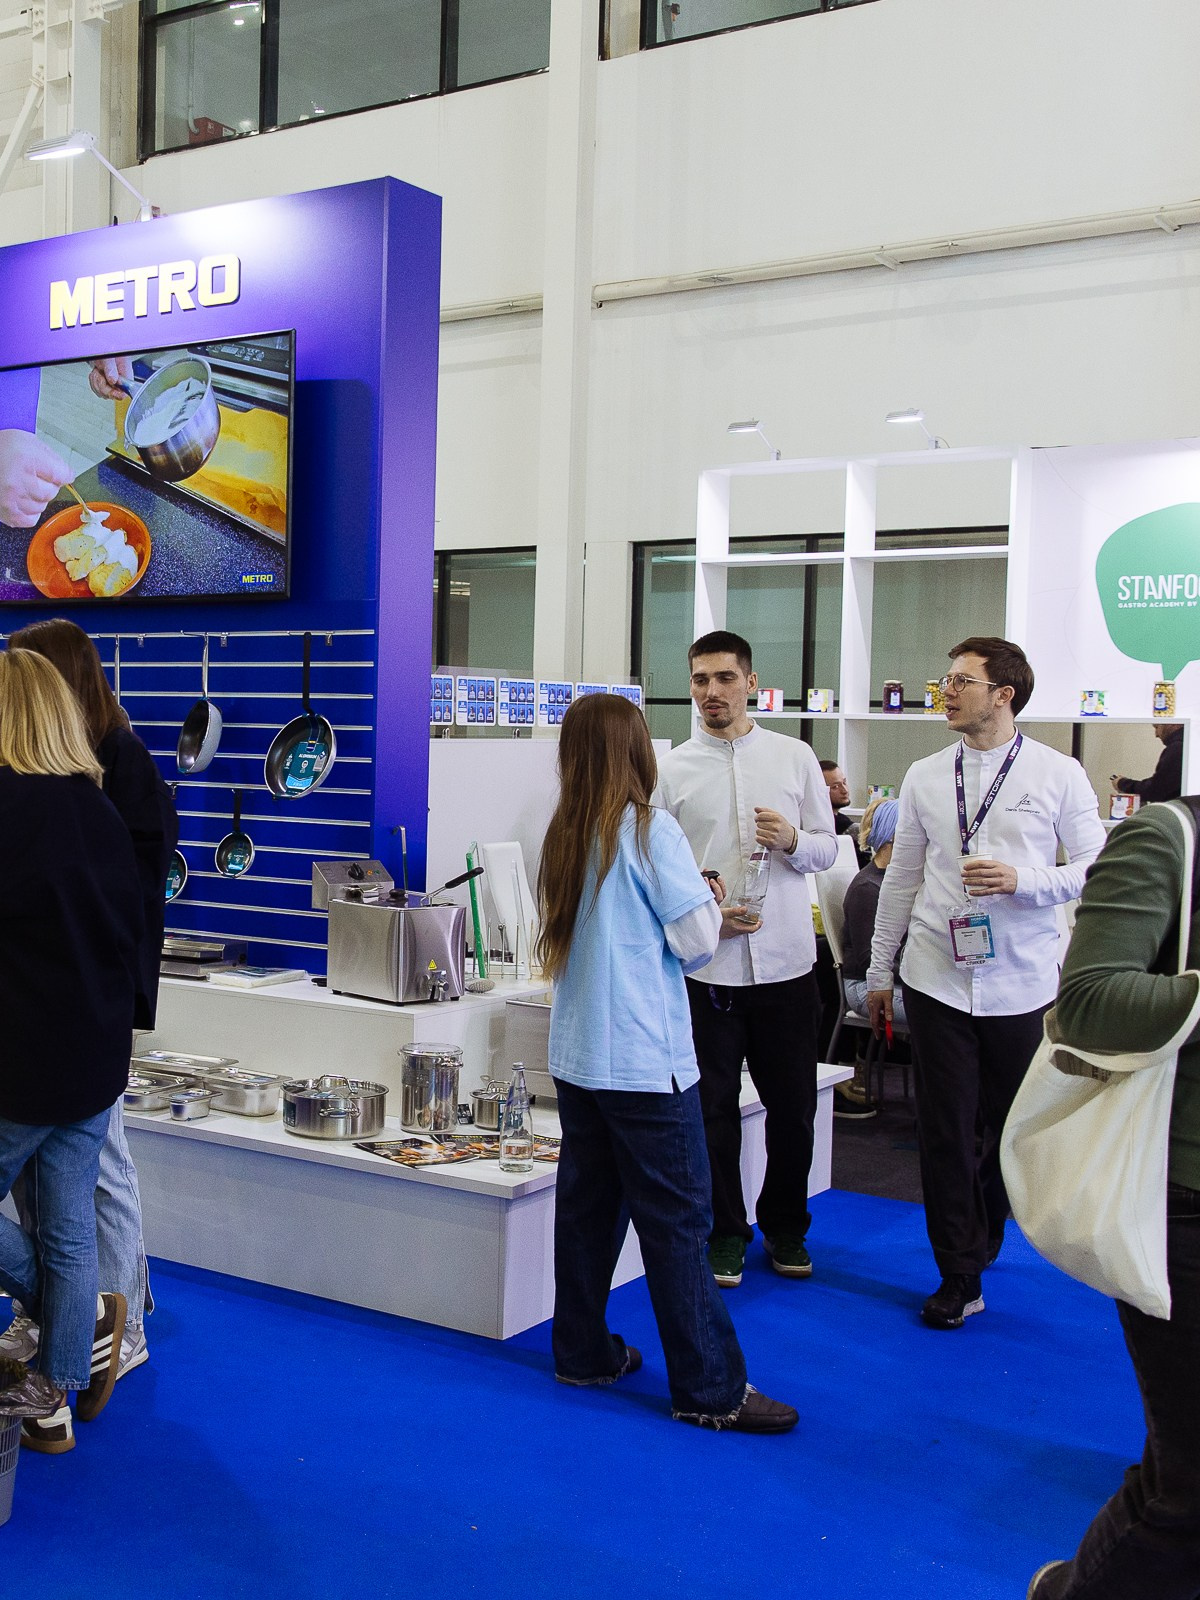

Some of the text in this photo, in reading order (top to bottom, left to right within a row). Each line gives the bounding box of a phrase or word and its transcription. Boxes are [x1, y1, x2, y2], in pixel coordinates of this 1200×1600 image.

[50, 253, 241, 330] METRO
[242, 574, 273, 583] METRO
[1117, 573, 1200, 601] STANFO
[1010, 744, 1020, 757] BWT
[984, 772, 1006, 810] ASTORIA
[969, 820, 980, 834] BWT
